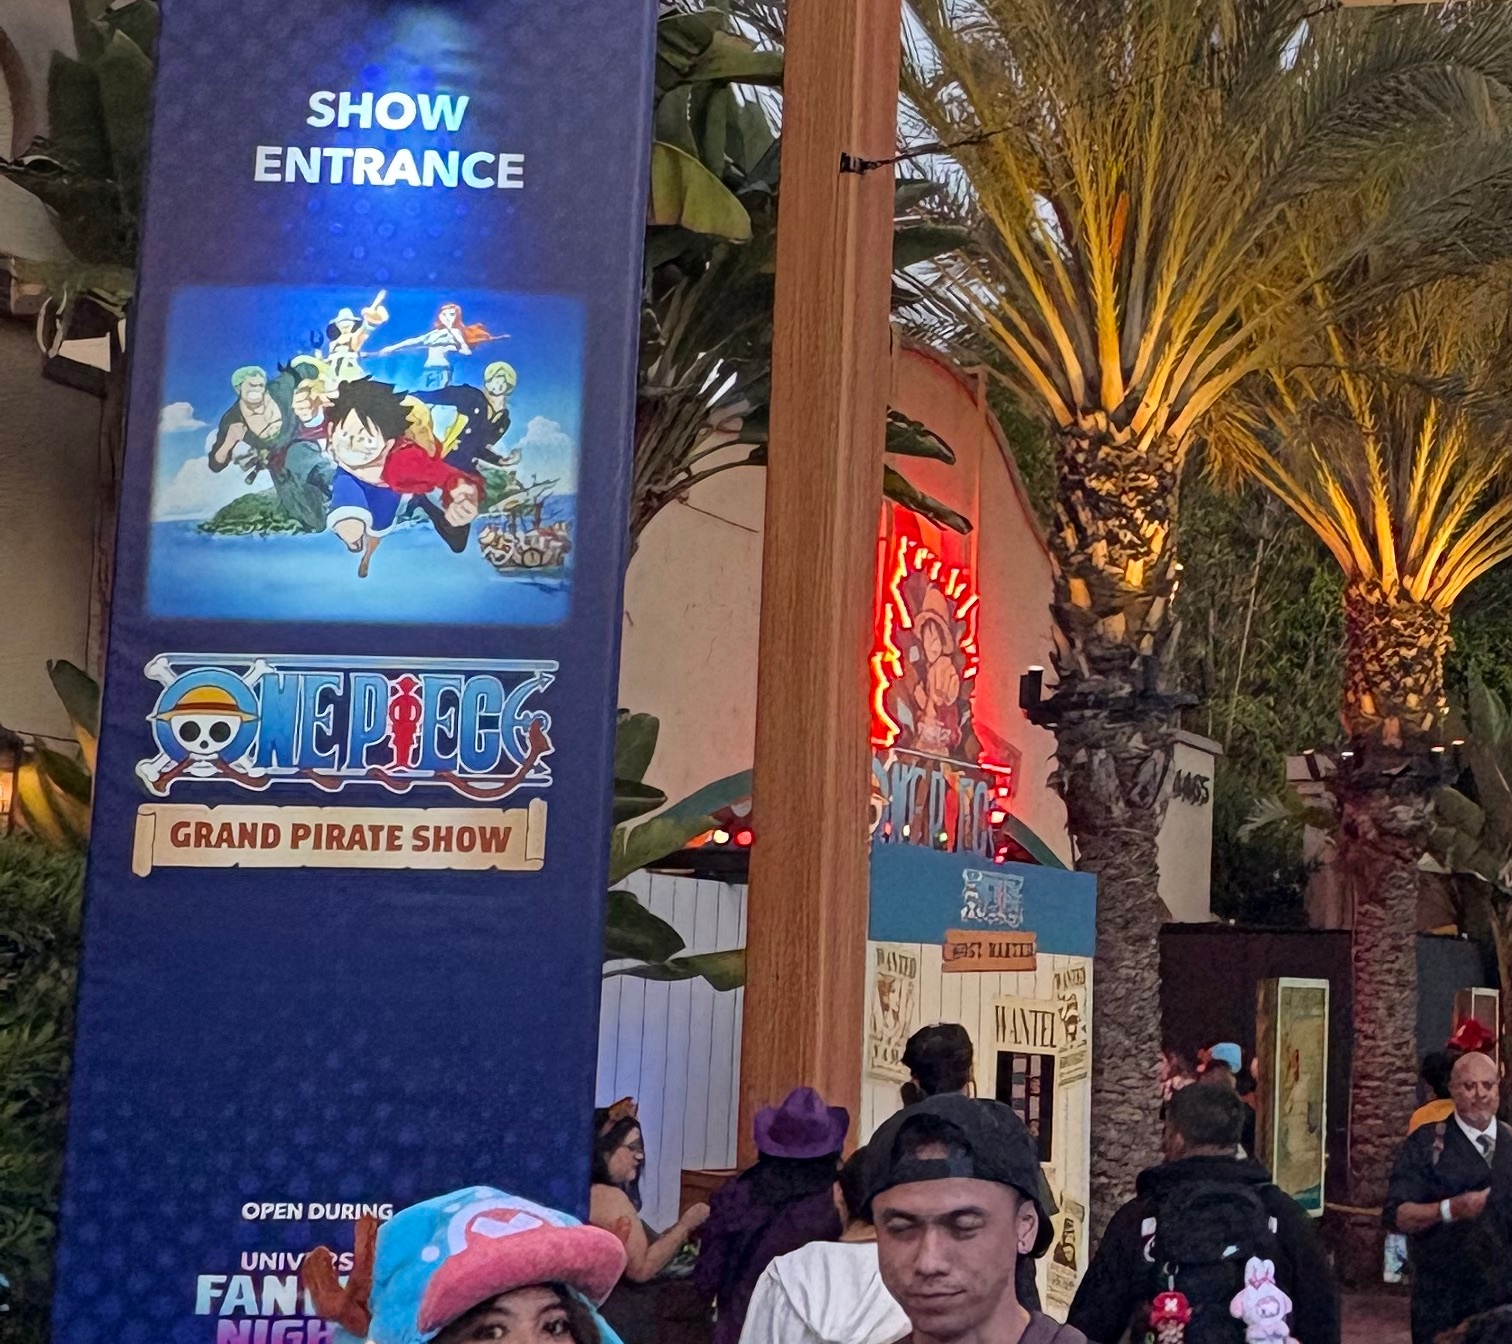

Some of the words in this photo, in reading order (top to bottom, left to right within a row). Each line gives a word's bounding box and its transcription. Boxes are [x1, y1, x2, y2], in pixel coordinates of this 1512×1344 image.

[305, 90, 471, 133] SHOW
[252, 144, 526, 190] ENTRANCE
[152, 666, 346, 771] ONE
[347, 670, 556, 775] PIECE
[169, 820, 282, 850] GRAND
[290, 822, 405, 853] PIRATE
[411, 824, 513, 854] SHOW
[240, 1201, 304, 1221] OPEN
[307, 1202, 394, 1221] DURING
[240, 1251, 356, 1272] UNIVS
[194, 1274, 299, 1317] FAN
